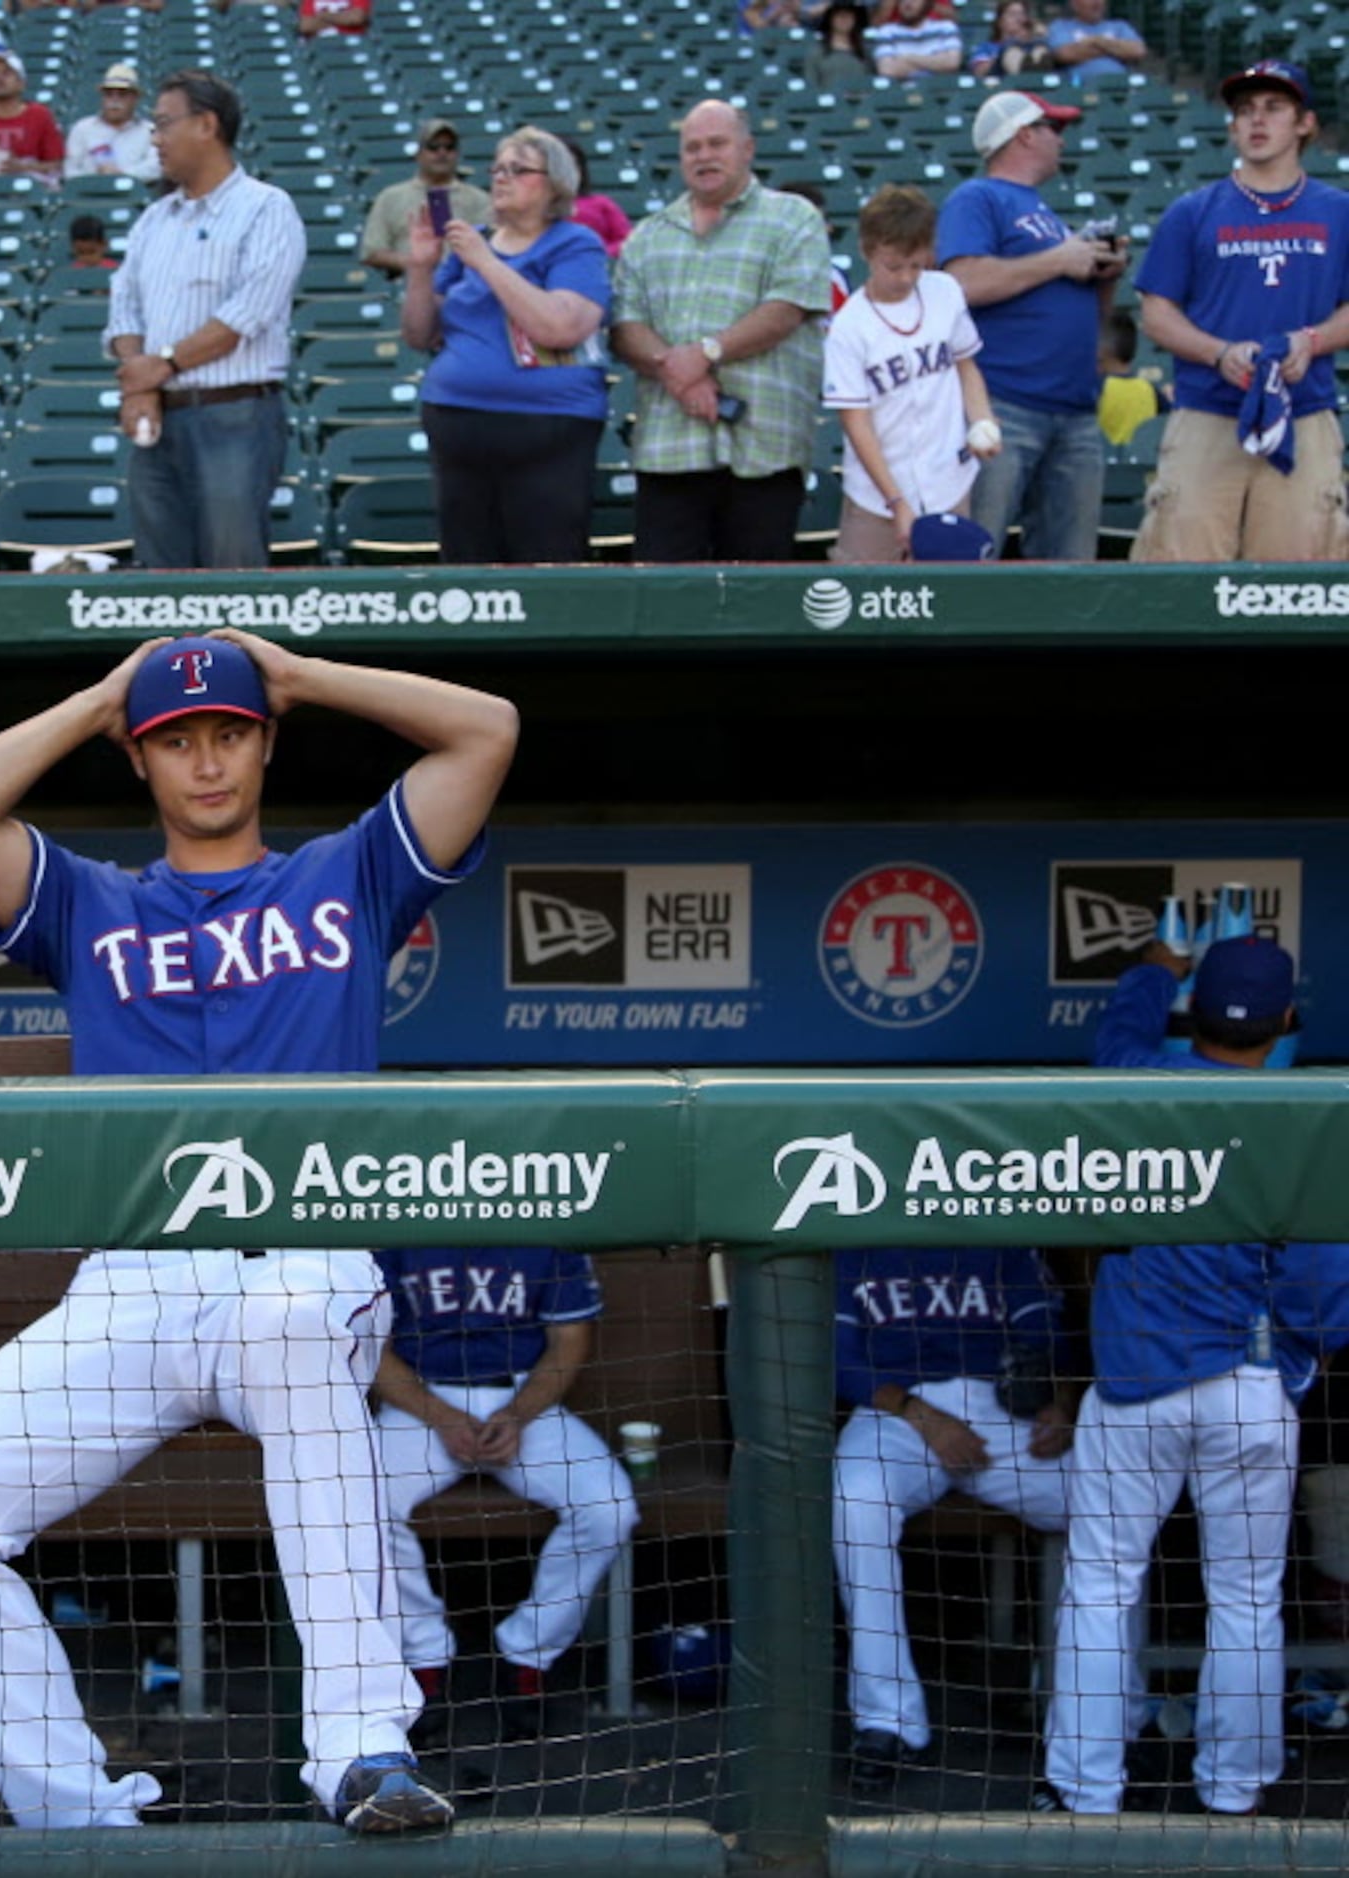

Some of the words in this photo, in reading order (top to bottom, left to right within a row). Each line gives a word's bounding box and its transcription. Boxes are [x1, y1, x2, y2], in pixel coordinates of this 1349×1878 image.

[1217, 238, 1303, 258] BASEBALL
[1258, 253, 1287, 287] T
[67, 587, 526, 636] texasrangers.com
[859, 586, 935, 619] at&t
[169, 650, 213, 694] T
[645, 892, 731, 925] NEW
[92, 898, 354, 1004] TEXAS
[646, 928, 731, 961] ERA
[871, 914, 932, 981] T
[504, 1002, 548, 1029] FLY
[554, 1002, 620, 1029] YOUR
[623, 1002, 683, 1029] OWN
[687, 1002, 749, 1029] FLAG
[1048, 998, 1092, 1027] FLY
[292, 1139, 610, 1211] Academy
[905, 1135, 1224, 1206] Academy
[292, 1200, 573, 1220] SPORTS+OUTDOORS
[905, 1195, 1185, 1216] SPORTS+OUTDOORS
